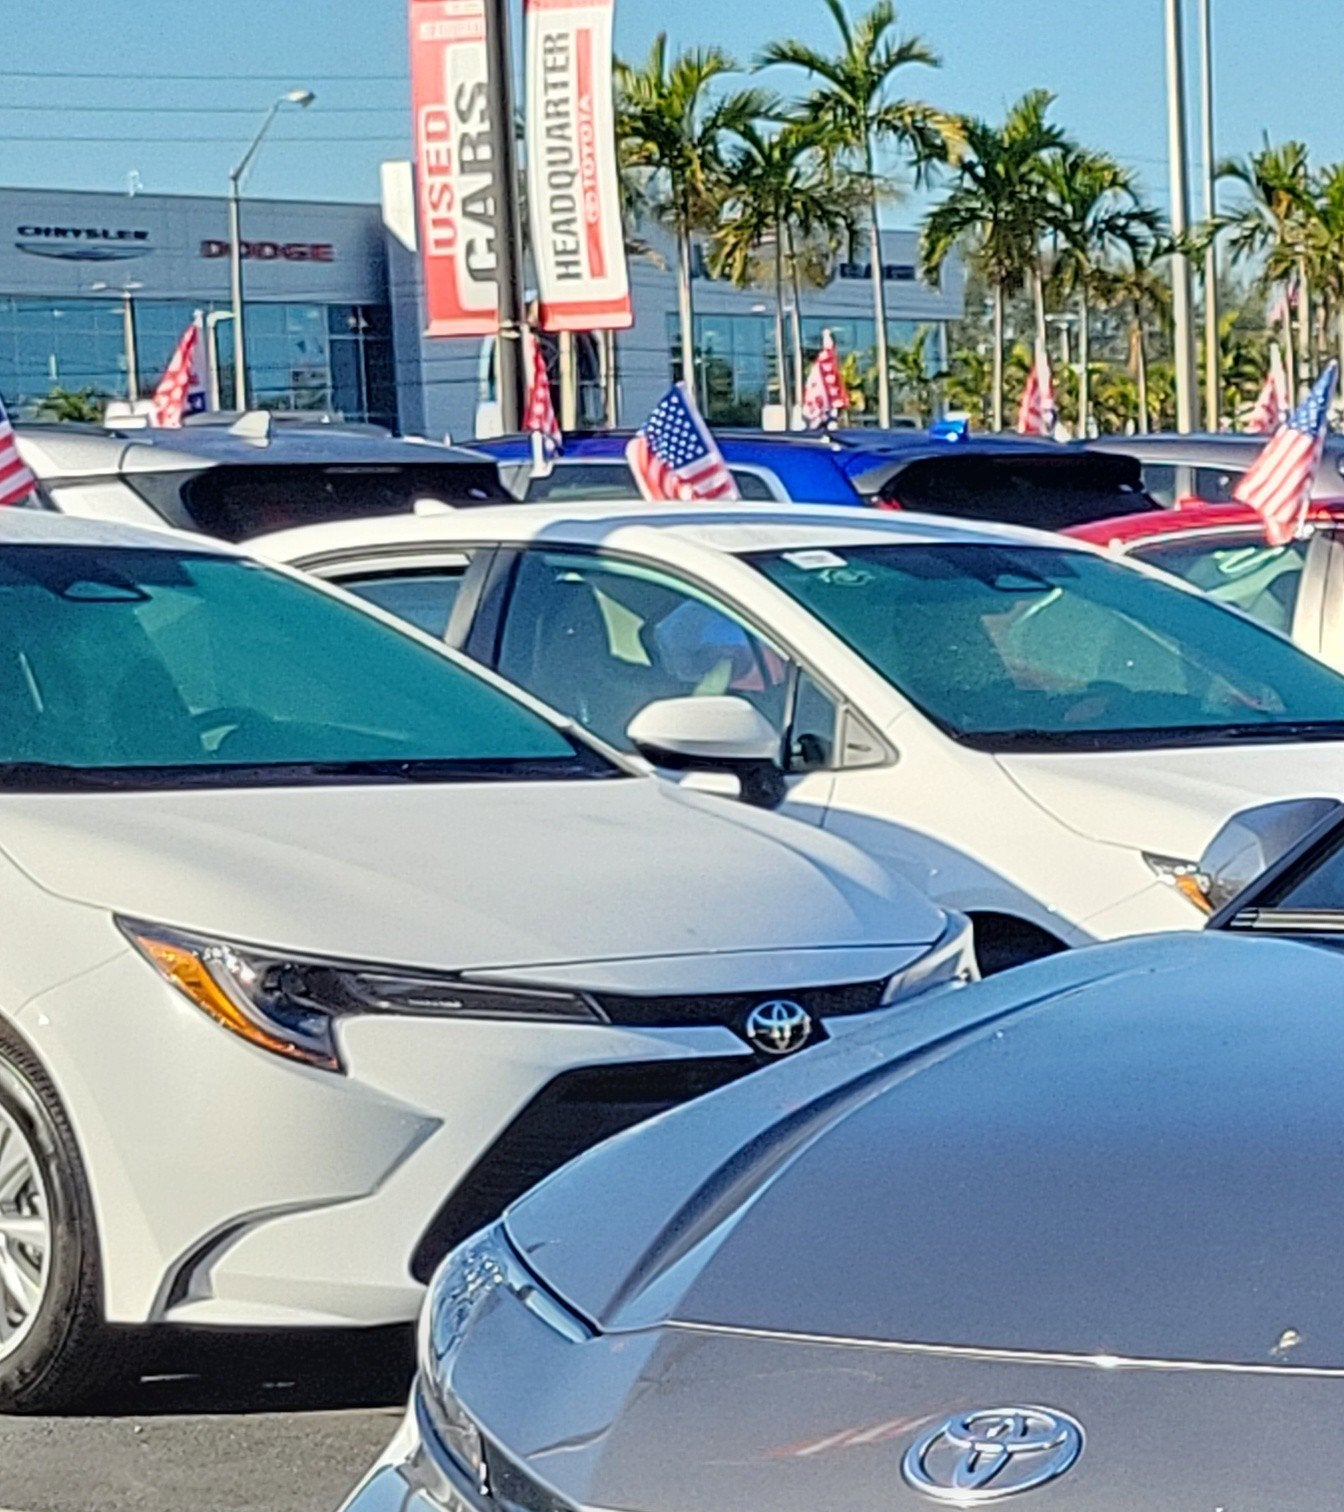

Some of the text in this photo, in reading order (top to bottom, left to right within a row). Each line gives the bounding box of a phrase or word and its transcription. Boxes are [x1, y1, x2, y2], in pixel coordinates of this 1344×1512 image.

[425, 110, 456, 251] USED
[455, 80, 499, 283] CARS
[543, 31, 583, 282] HEADQUARTER
[17, 226, 149, 240] CHRYSLER
[201, 239, 334, 262] DODGE
